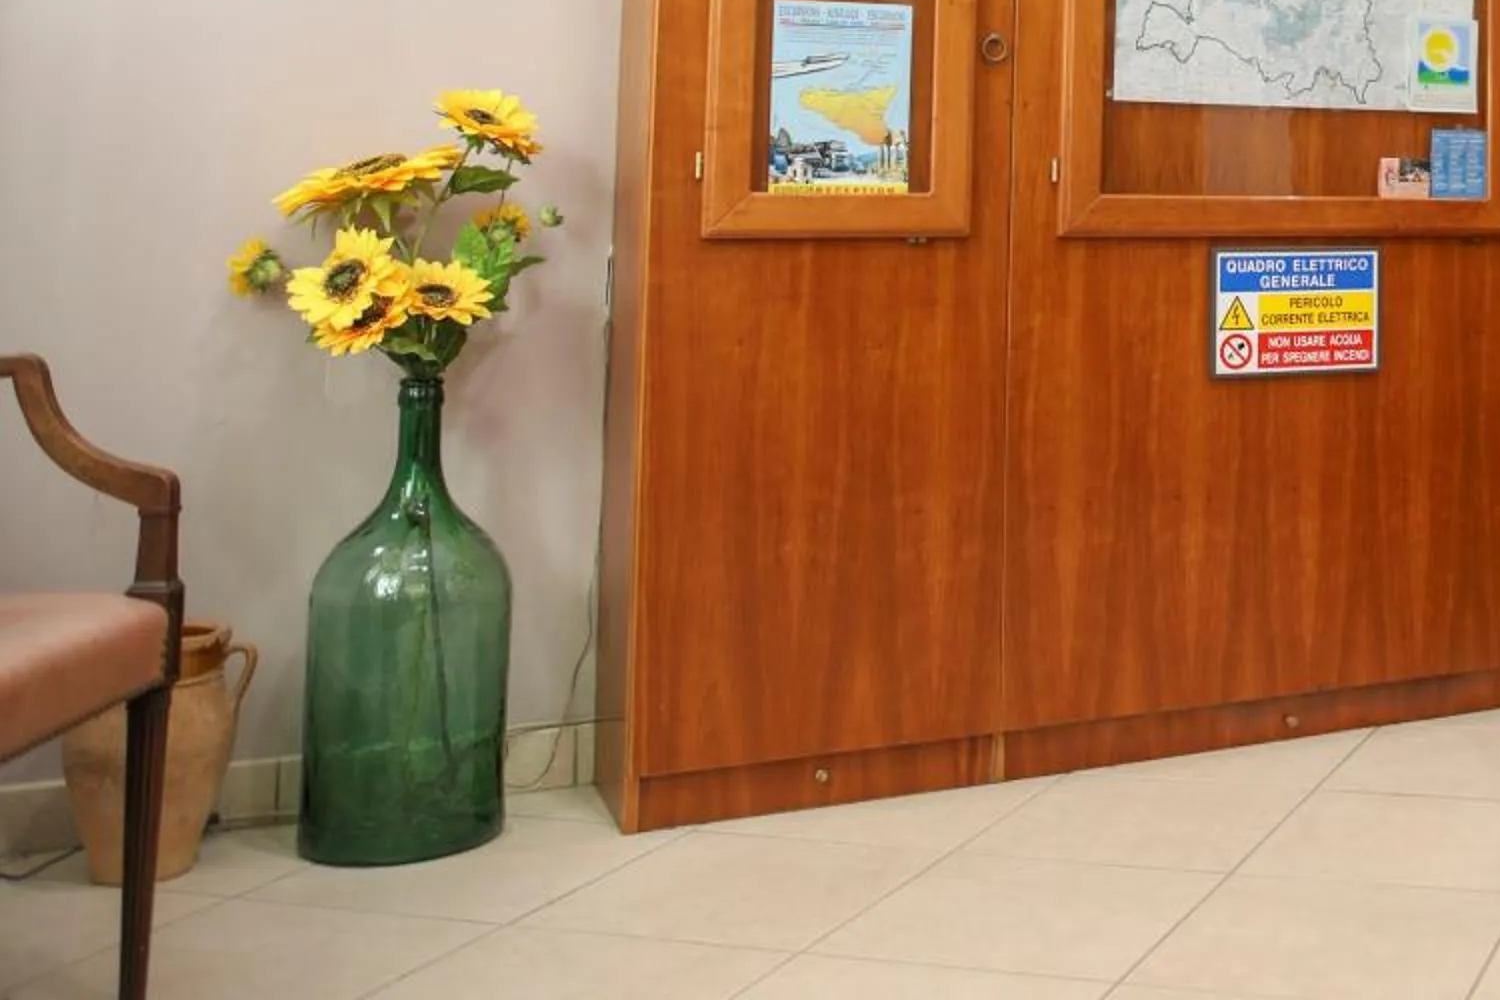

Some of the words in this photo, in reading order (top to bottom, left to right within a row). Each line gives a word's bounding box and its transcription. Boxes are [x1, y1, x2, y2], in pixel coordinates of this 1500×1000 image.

[1226, 259, 1286, 273] QUADRO
[1293, 258, 1369, 272] ELETTRICO
[1259, 274, 1336, 288] GENERALE
[1289, 296, 1343, 308] PERICOLO
[1261, 312, 1313, 326] CORRENTE
[1318, 310, 1370, 323] ELETTRICA
[1268, 336, 1290, 348] NON
[1293, 335, 1325, 347] USARE
[1329, 333, 1362, 345] ACQUA
[1262, 352, 1279, 364] PER
[1283, 350, 1331, 363] SPEGNERE
